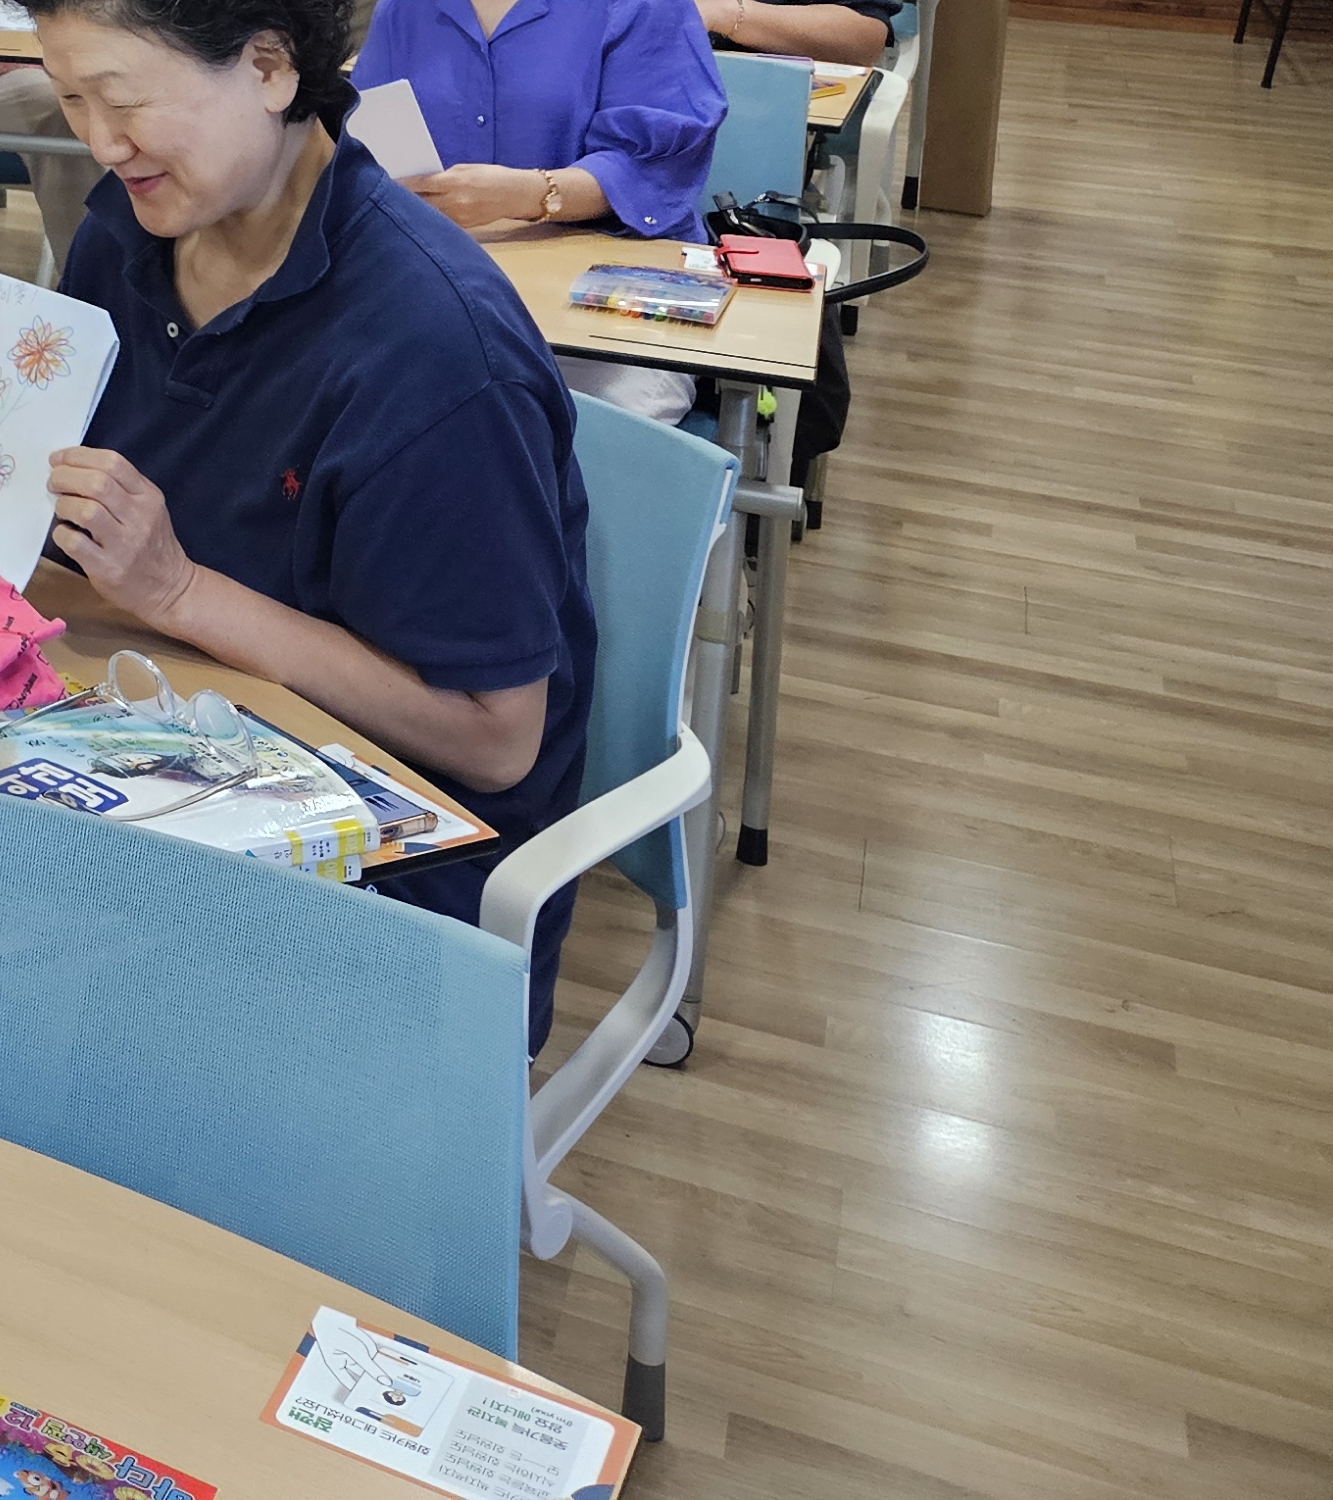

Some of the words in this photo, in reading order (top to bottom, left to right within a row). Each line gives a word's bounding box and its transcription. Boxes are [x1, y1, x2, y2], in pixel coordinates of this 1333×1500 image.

[4, 1408, 36, 1431] 12
[288, 1406, 334, 1434] 잠깐!
[295, 1396, 377, 1435] 태그하셨나요?
[466, 1405, 509, 1428] 복지관
[530, 1406, 556, 1419] your)
[534, 1416, 563, 1434] 암요
[41, 1418, 114, 1460] 색연필
[379, 1429, 432, 1456] 회원카드
[454, 1428, 506, 1454] 회원님도
[511, 1422, 570, 1451] 웃음가득
[444, 1451, 495, 1478] 회원님도
[449, 1440, 500, 1466] 회원님도
[503, 1461, 555, 1488] 식사하는
